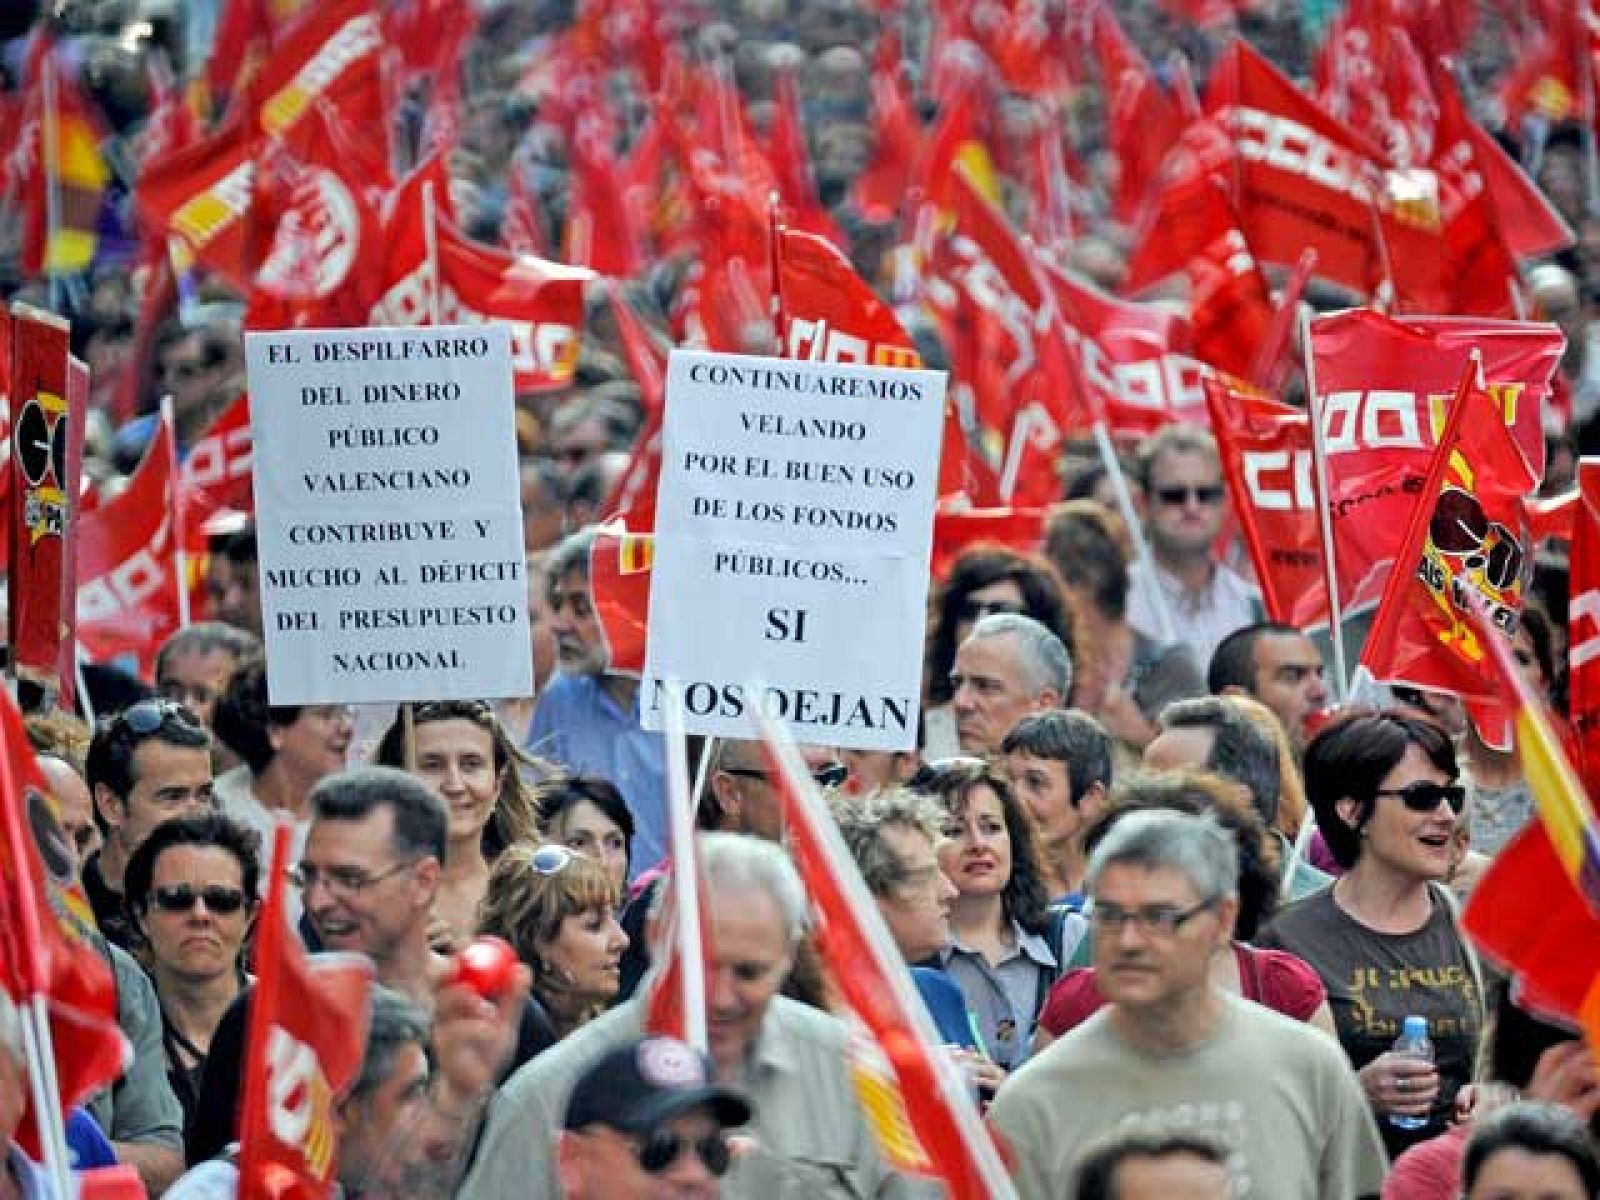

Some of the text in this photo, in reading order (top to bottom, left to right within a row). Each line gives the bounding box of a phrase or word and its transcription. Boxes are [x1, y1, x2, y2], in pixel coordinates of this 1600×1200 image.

[268, 344, 301, 364] EL
[314, 337, 489, 362] DESPILFARRO
[301, 380, 461, 406] DEL DINERO
[689, 363, 922, 401] CONTINUAREMOS
[328, 424, 439, 448] PÚBLICO
[740, 411, 866, 441] VELANDO
[303, 468, 471, 492] VALENCIANO
[684, 452, 915, 490] POR EL BUEN USO
[692, 496, 898, 533] DE LOS FONDOS
[289, 519, 491, 545] CONTRIBUYE Y
[266, 559, 521, 588] MUCHO AL DÉFICIT
[339, 604, 516, 630] PRESUPUESTO
[764, 608, 809, 643] SI
[332, 649, 466, 673] NACIONAL
